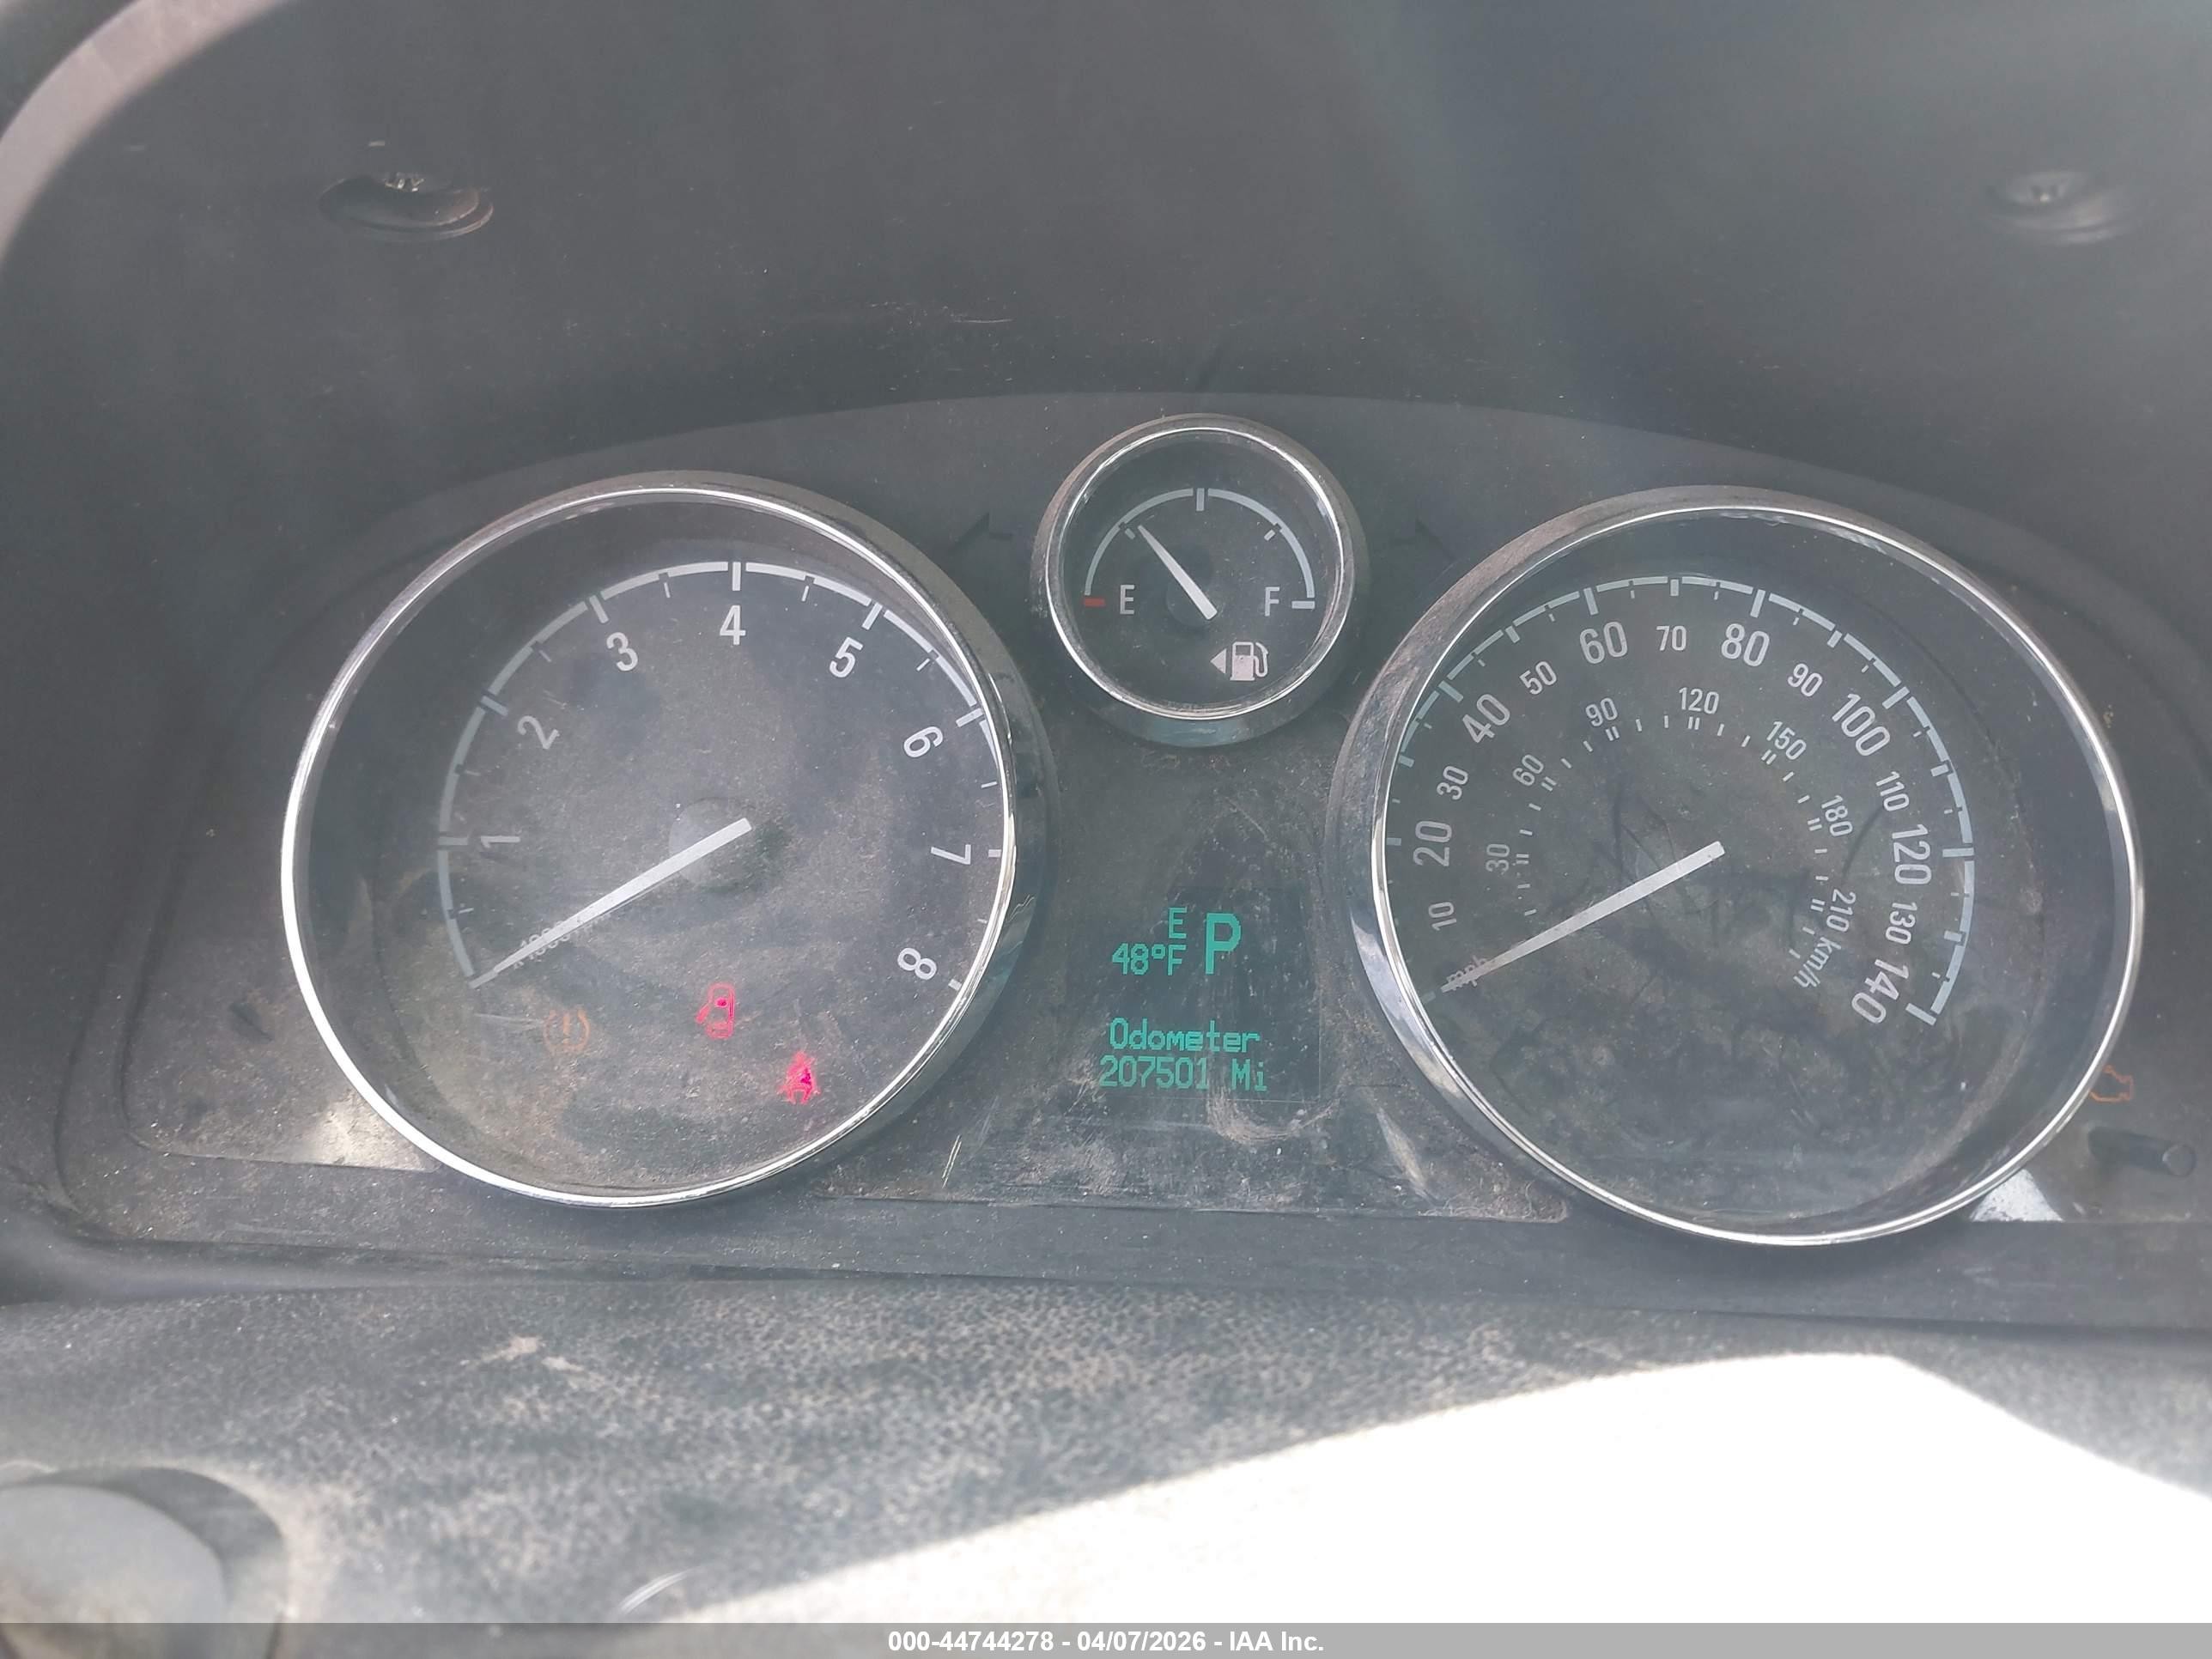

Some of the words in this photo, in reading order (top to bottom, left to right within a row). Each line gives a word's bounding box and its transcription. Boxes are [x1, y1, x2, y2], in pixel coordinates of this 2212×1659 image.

[1120, 585, 1135, 615] E
[1265, 586, 1280, 617] F
[720, 605, 745, 645] 4
[1579, 621, 1628, 665] 60
[1656, 625, 1687, 651] 70
[605, 631, 638, 672] 3
[830, 636, 863, 678] 5
[1721, 623, 1770, 666] 80
[1520, 660, 1558, 696] 50
[1787, 664, 1823, 696] 90
[1461, 694, 1511, 744] 40
[1585, 697, 1619, 726] 90
[1679, 688, 1720, 715] 120
[517, 714, 559, 750] 2
[902, 726, 943, 759] 6
[1764, 720, 1807, 760] 150
[1831, 693, 1891, 757] 100
[1437, 766, 1468, 799] 30
[1512, 753, 1544, 786] 60
[1876, 771, 1910, 811] 110
[1821, 795, 1853, 836] 180
[480, 836, 520, 848] 1
[931, 843, 971, 865] 7
[1413, 821, 1452, 866] 20
[1486, 843, 1510, 874] 30
[1892, 824, 1931, 884] 120
[1169, 907, 1187, 939] E
[1428, 902, 1457, 932] 10
[1826, 889, 1856, 932] 210
[1885, 902, 1917, 945] 130
[1112, 943, 1187, 975] 48°F
[1206, 913, 1241, 975] P
[896, 946, 938, 980] 8
[1793, 937, 1842, 988] km/h
[1851, 959, 1909, 1024] 140
[1109, 1018, 1260, 1053] Odometer
[1099, 1055, 1209, 1090] 207501
[1231, 1059, 1267, 1091] Mi
